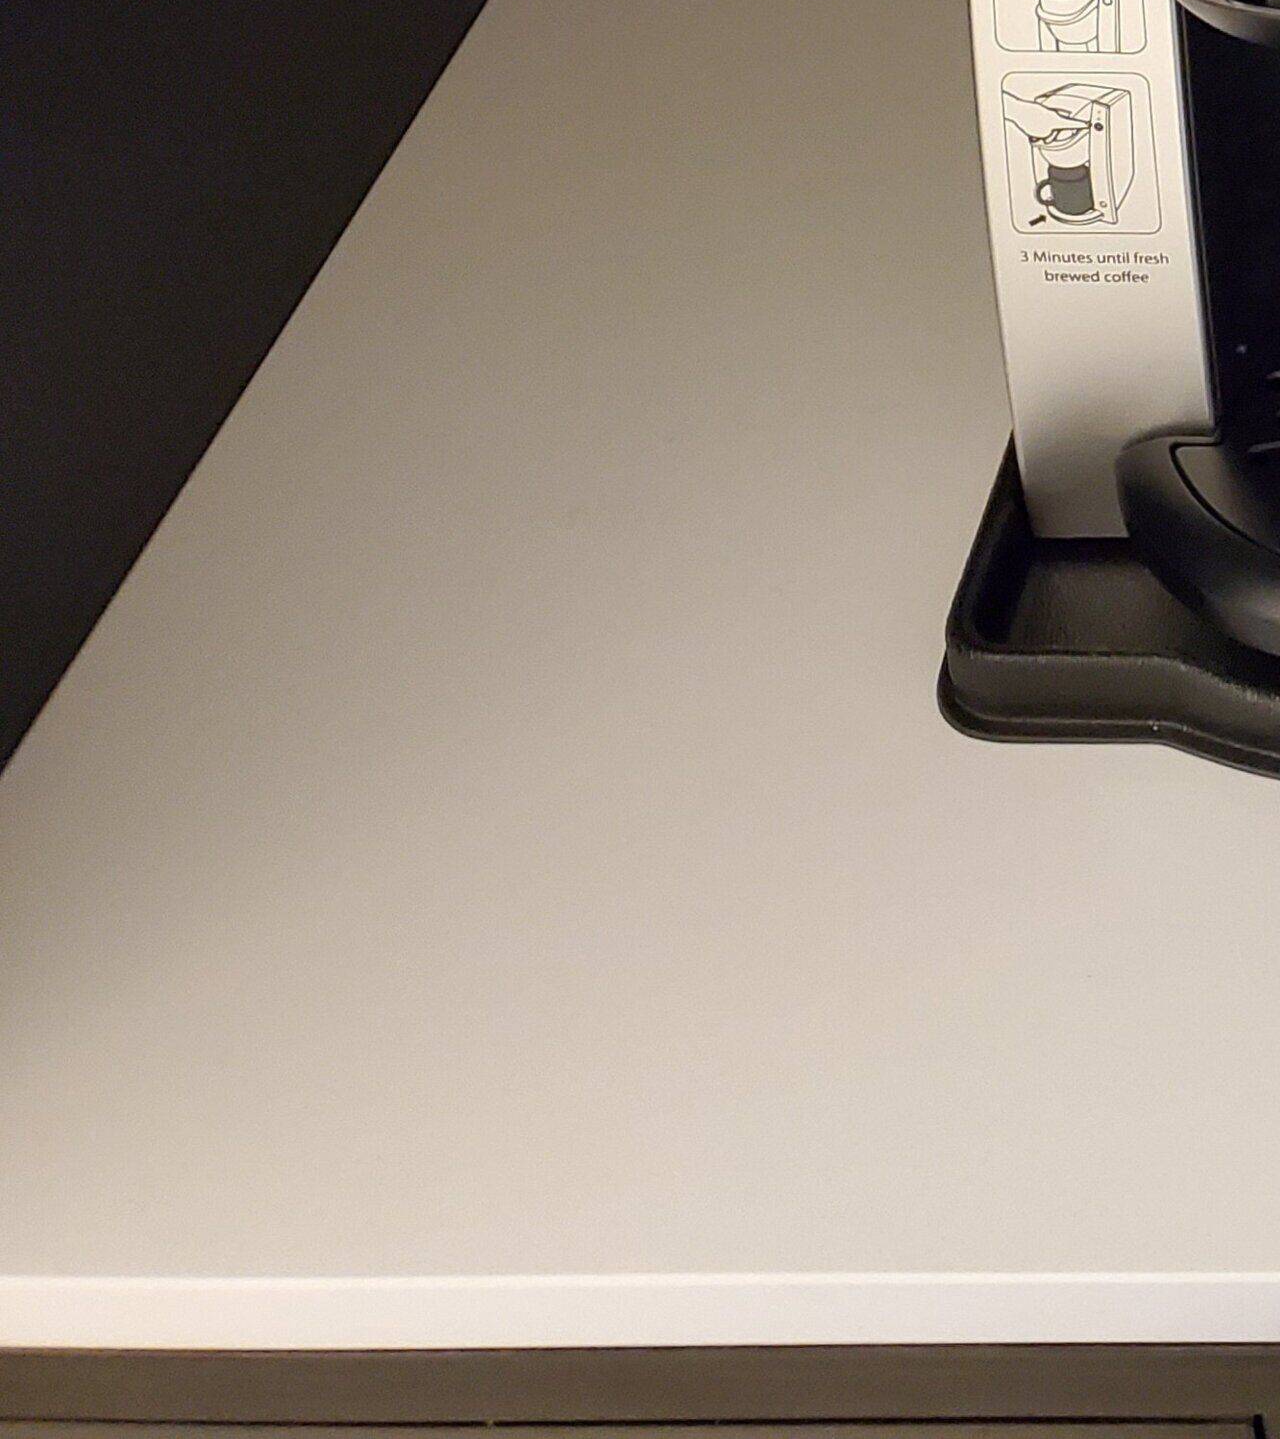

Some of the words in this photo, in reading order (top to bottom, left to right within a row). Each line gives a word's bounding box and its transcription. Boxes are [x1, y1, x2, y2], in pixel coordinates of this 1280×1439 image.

[1020, 250, 1030, 263] 3
[1033, 250, 1094, 264] Minutes
[1097, 251, 1131, 265] until
[1134, 251, 1170, 265] fresh
[1045, 269, 1100, 283] brewed
[1104, 270, 1150, 283] coffee
